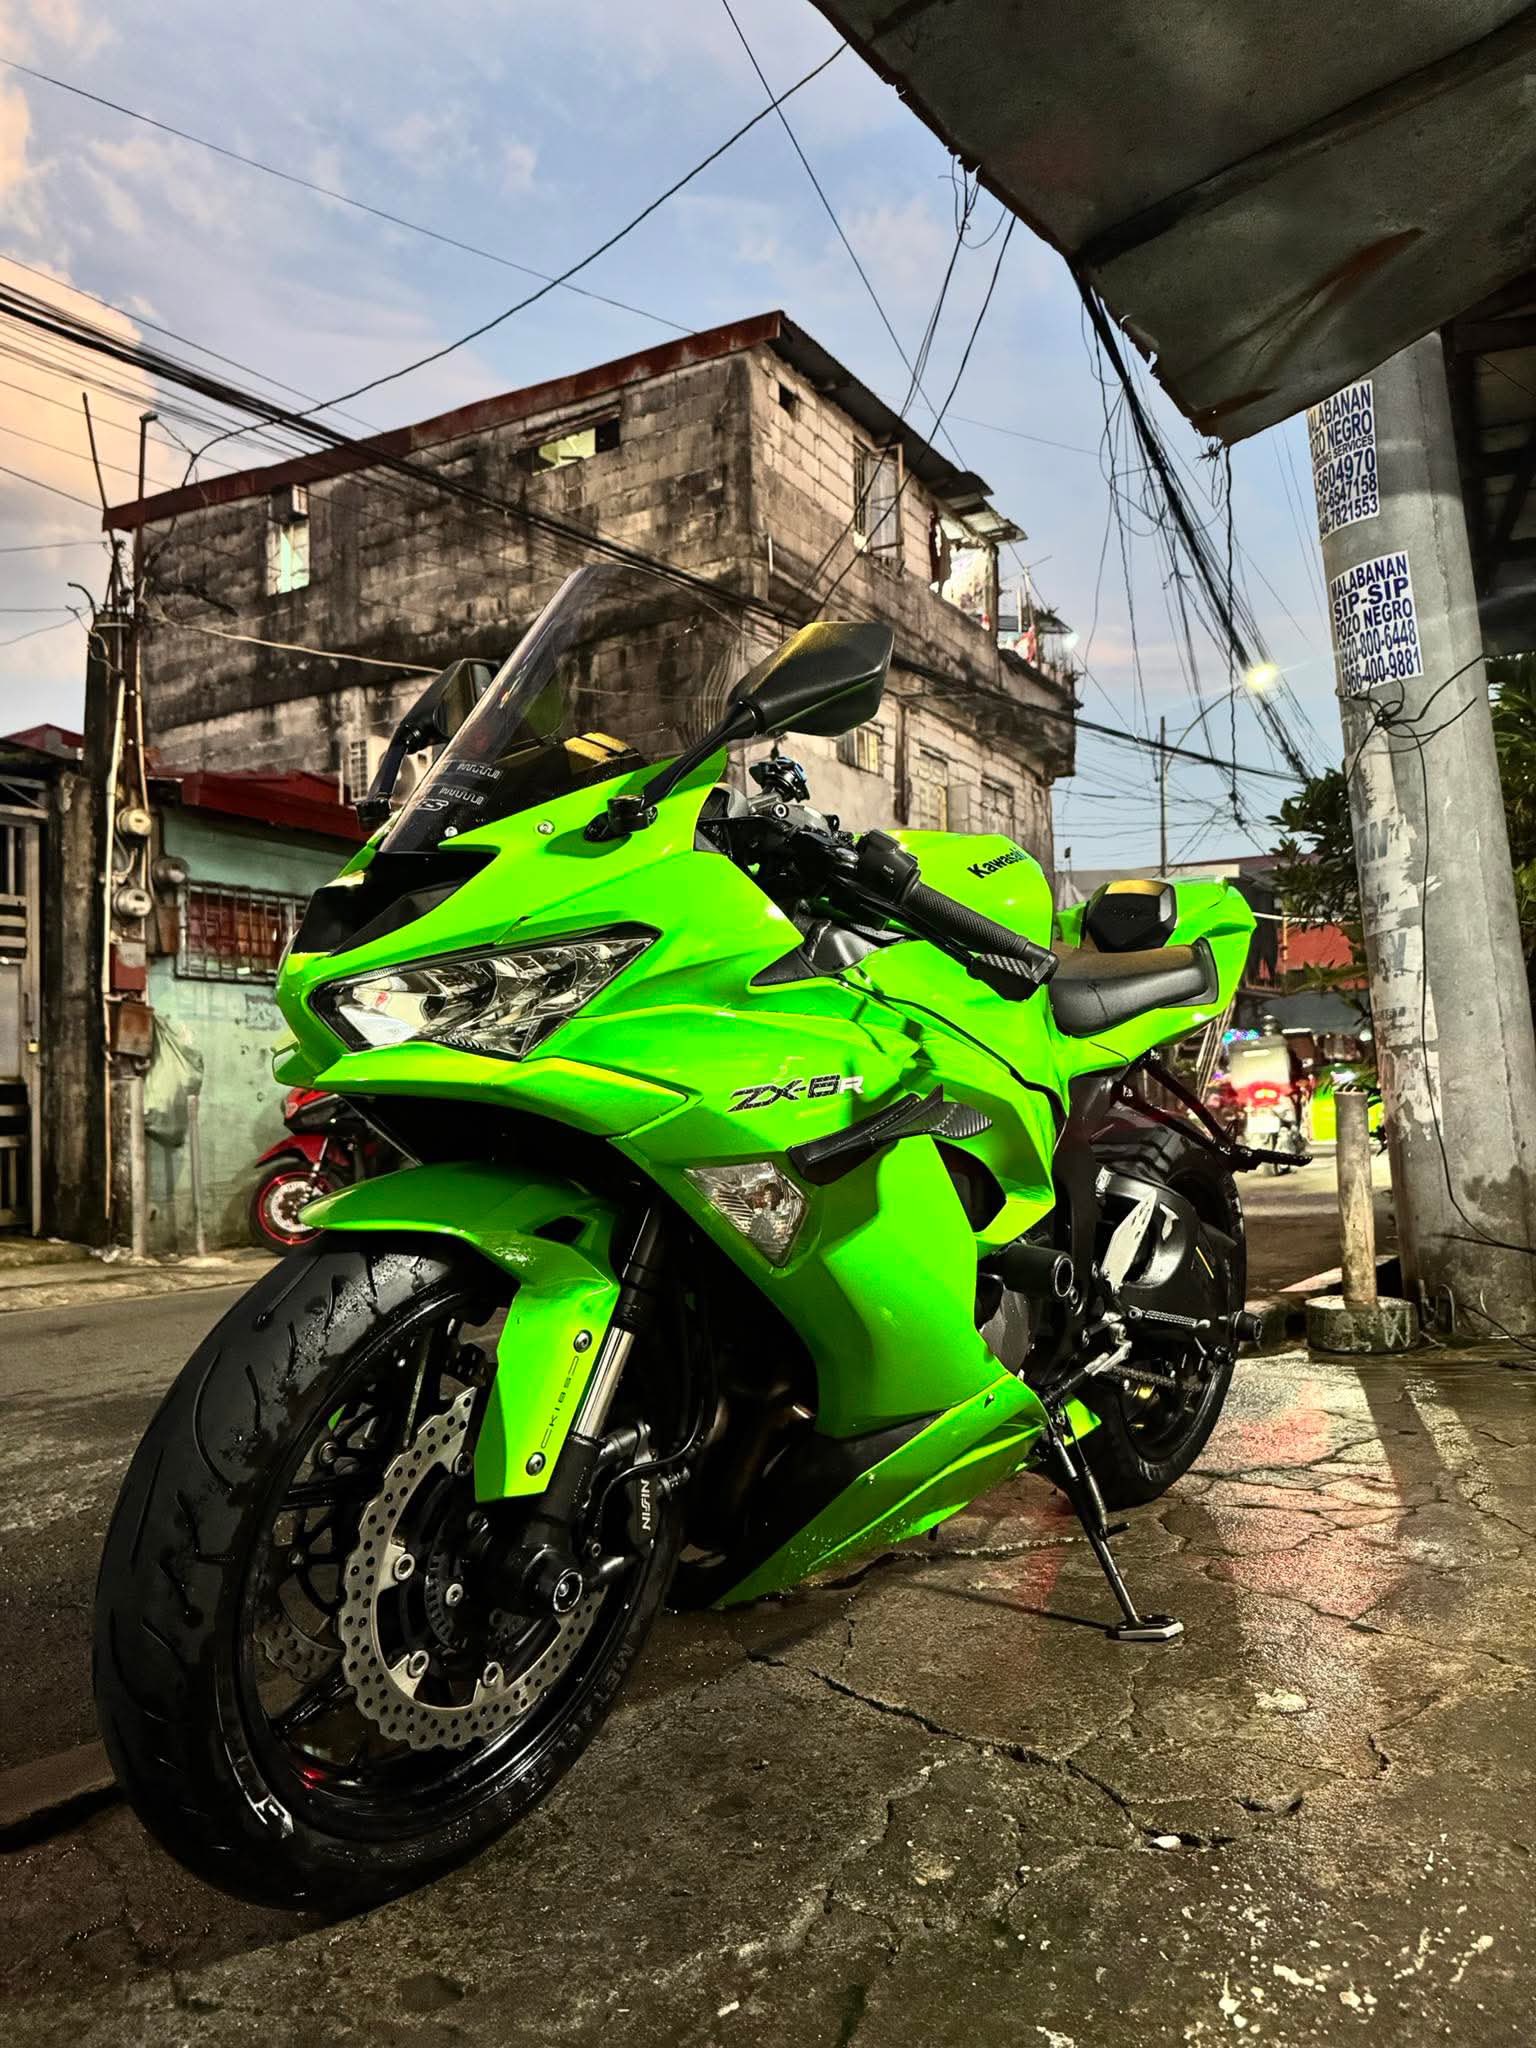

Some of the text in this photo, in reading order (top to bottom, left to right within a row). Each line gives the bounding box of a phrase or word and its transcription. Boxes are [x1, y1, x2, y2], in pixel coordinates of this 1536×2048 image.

[1327, 411, 1373, 450] NEGRO
[1333, 434, 1374, 460] SERVICES
[1319, 472, 1377, 515] -6547158
[1320, 495, 1378, 536] -7821553
[1334, 577, 1409, 622] SIP-SIP
[1364, 598, 1413, 630] NEGRO
[727, 1074, 864, 1113] ZX-6R
[640, 1478, 651, 1532] NISSIN
